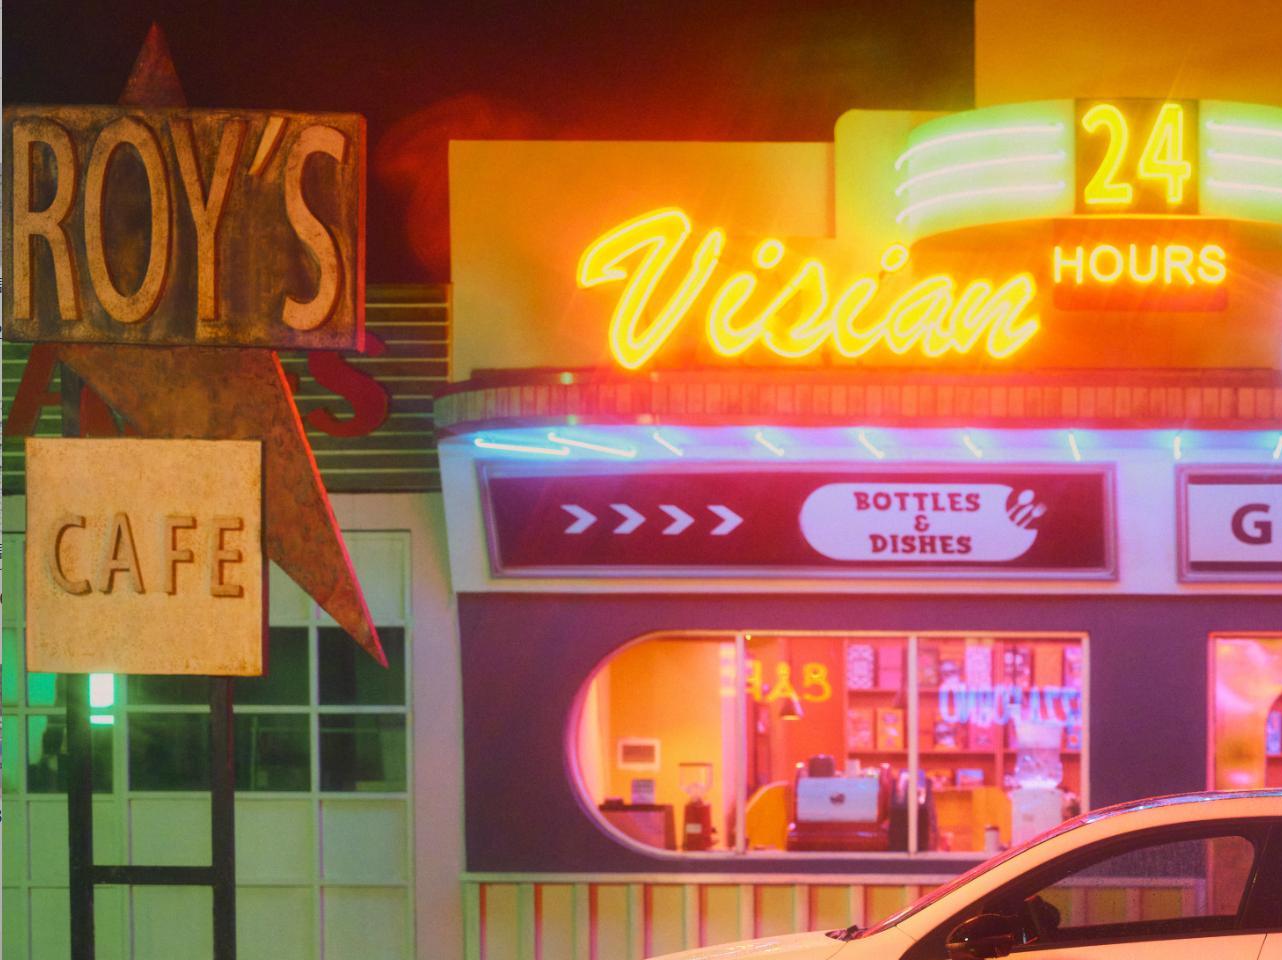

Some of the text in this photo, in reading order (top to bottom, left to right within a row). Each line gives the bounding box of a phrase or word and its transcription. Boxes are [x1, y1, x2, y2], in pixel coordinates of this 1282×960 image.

[1081, 102, 1192, 206] 24
[11, 113, 348, 332] ROY'S
[1052, 243, 1229, 285] HOURS
[853, 492, 981, 512] BOTTLES
[913, 514, 930, 532] &
[50, 512, 245, 598] CAFE
[869, 534, 972, 554] DISHES
